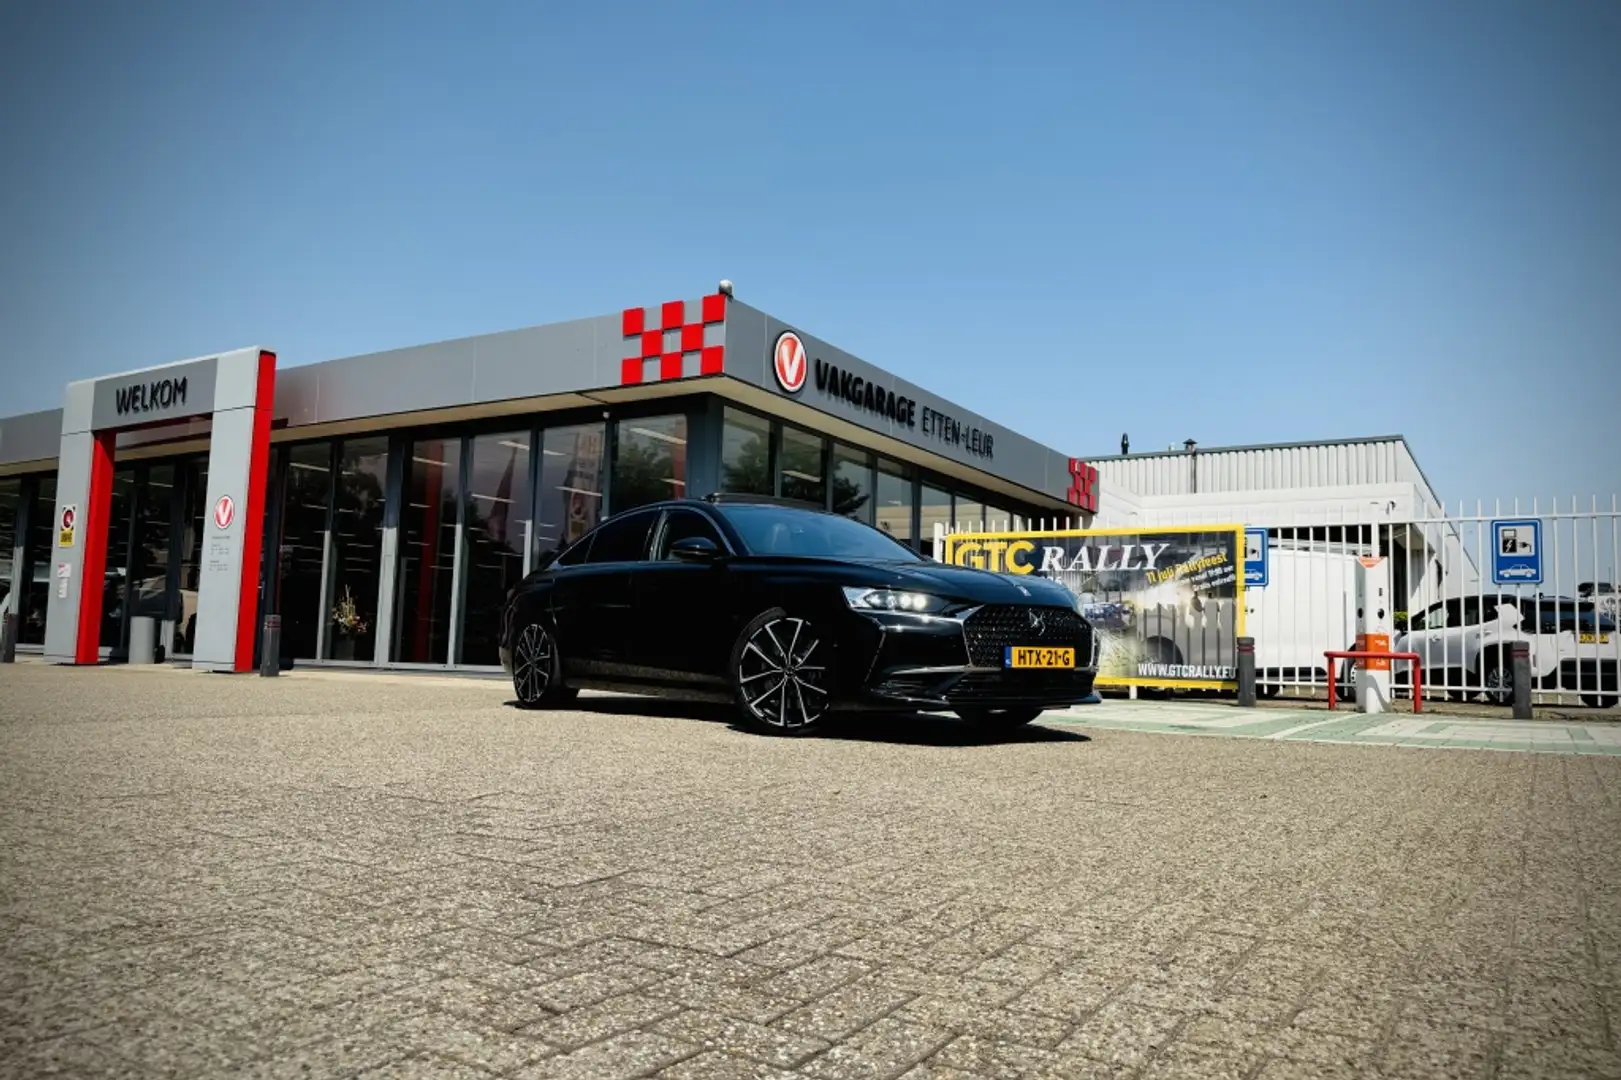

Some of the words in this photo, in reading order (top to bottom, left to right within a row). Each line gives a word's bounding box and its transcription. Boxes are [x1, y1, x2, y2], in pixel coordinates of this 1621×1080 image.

[780, 341, 806, 384] V
[116, 376, 187, 416] WELKOM
[815, 358, 916, 428] VAKGARAGE
[922, 406, 994, 459] ETTEN-LEUR
[955, 540, 1035, 575] GTC
[1037, 543, 1171, 572] RALLY
[1017, 649, 1070, 666] HTX-21-G
[1138, 663, 1237, 679] WWW.GTCRALLY.EU
